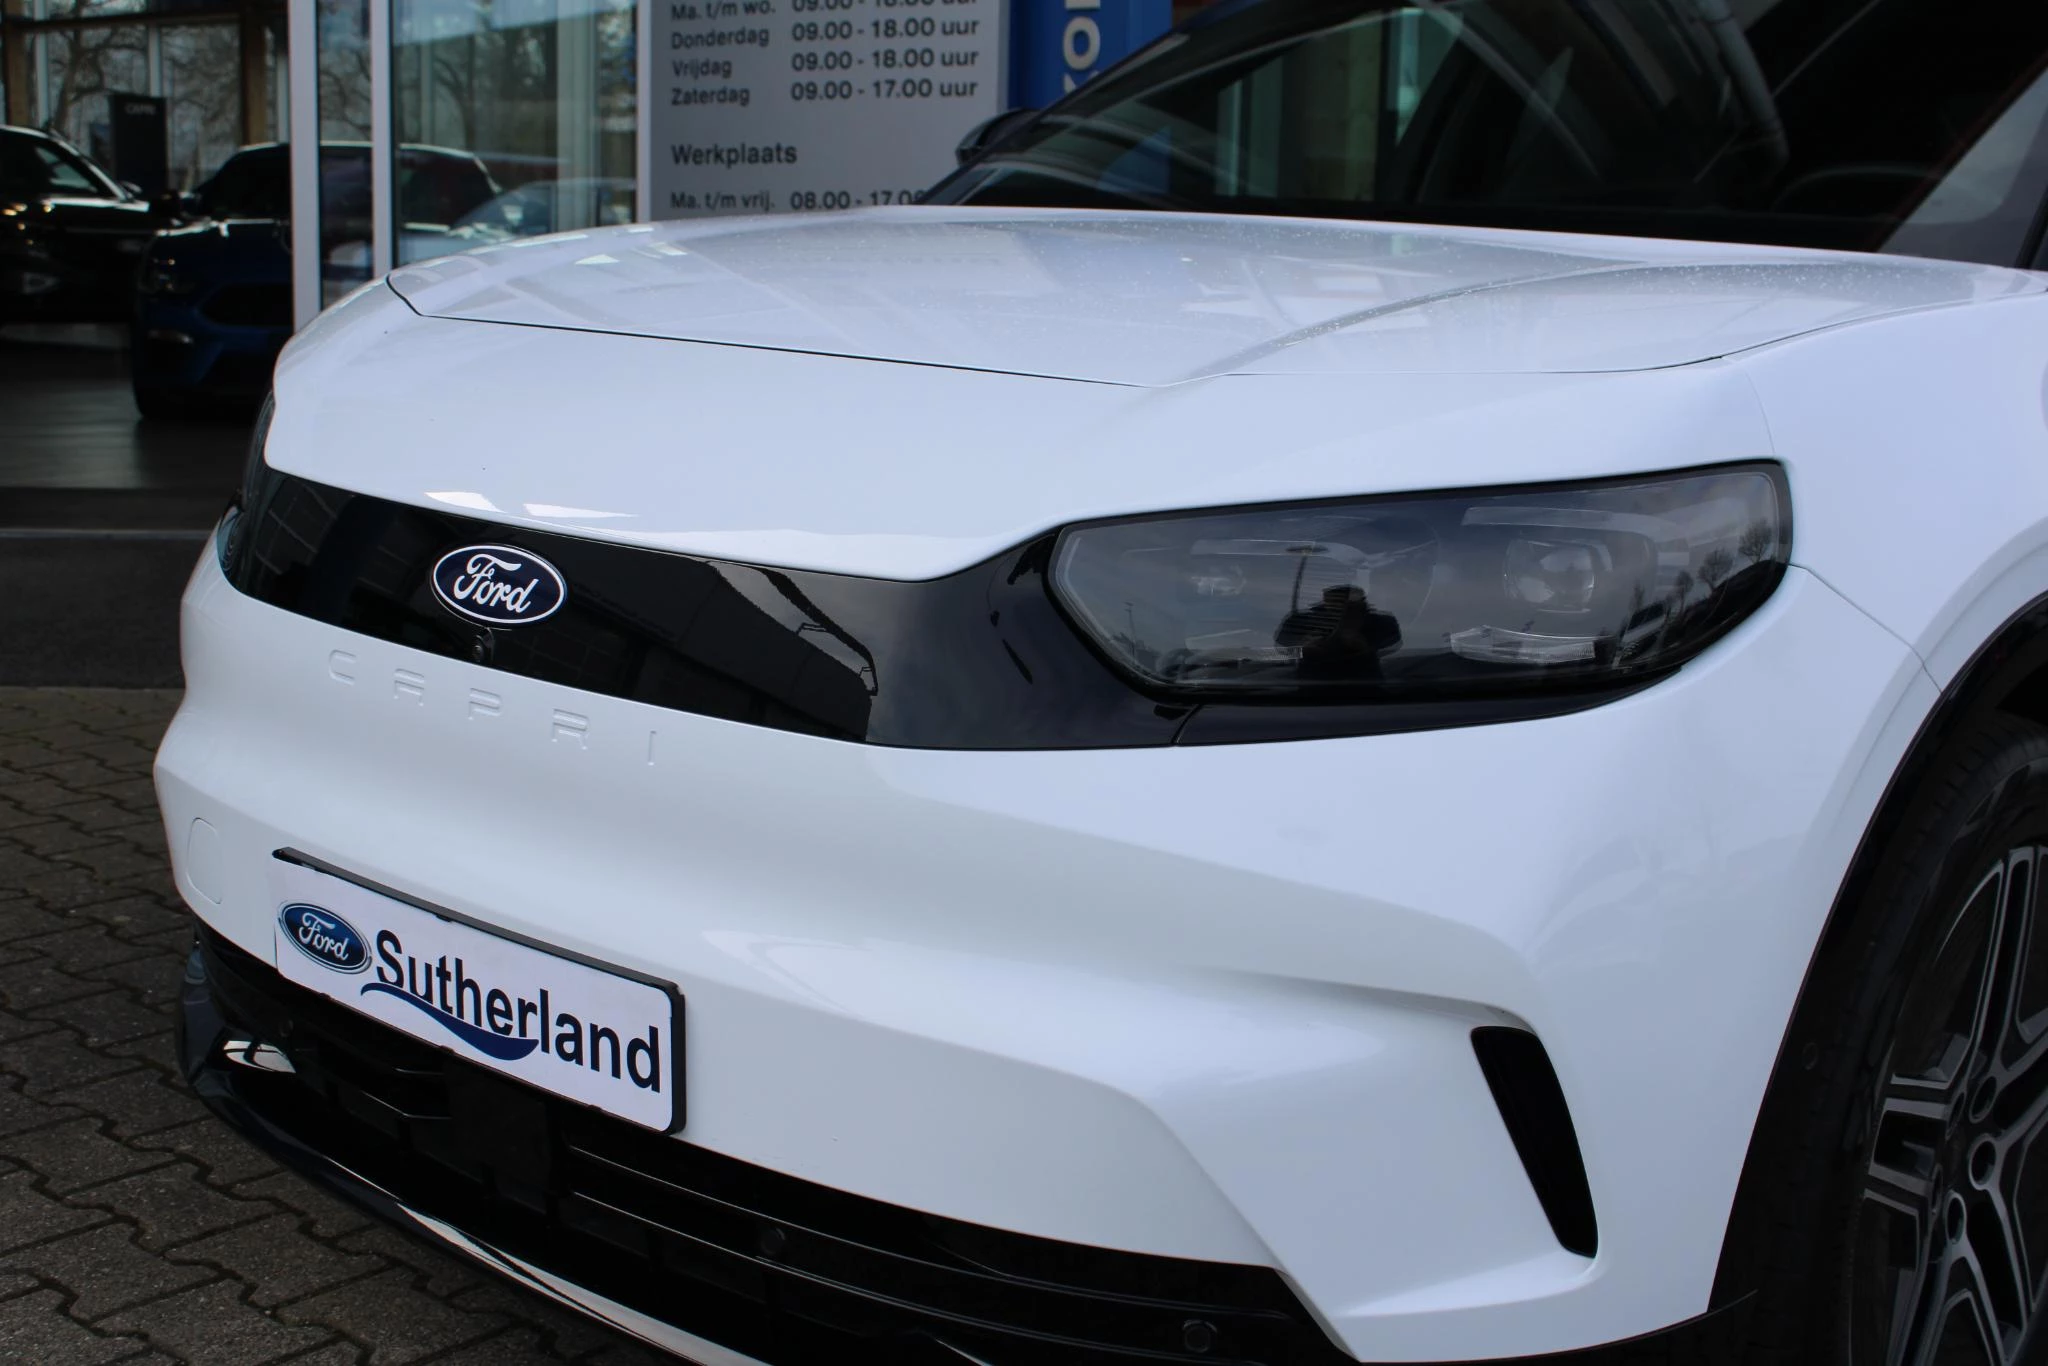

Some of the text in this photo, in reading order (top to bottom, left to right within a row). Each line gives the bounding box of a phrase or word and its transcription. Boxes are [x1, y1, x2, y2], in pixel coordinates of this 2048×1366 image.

[671, 3, 702, 20] Ma.
[743, 0, 776, 15] wo.
[671, 26, 769, 50] Donderdag
[791, 21, 853, 42] 09.00
[871, 17, 936, 39] 18.00
[941, 19, 980, 36] uur
[671, 58, 732, 80] Vrijdag
[791, 51, 853, 72] 09.00
[871, 48, 935, 70] 18.00
[941, 50, 980, 67] uur
[671, 86, 750, 107] Zaterdag
[790, 80, 853, 101] 09.00
[872, 78, 933, 99] 17.00
[939, 79, 979, 97] uur
[671, 142, 798, 168] Werkplaats
[671, 191, 702, 209] Ma.
[705, 191, 737, 211] t/m
[741, 189, 776, 213] vrij.
[790, 190, 850, 210] 08.00
[869, 190, 927, 205] 170
[453, 553, 539, 613] Ford
[328, 649, 657, 766] CAPRI
[298, 912, 662, 1094] Ford Sutherland
